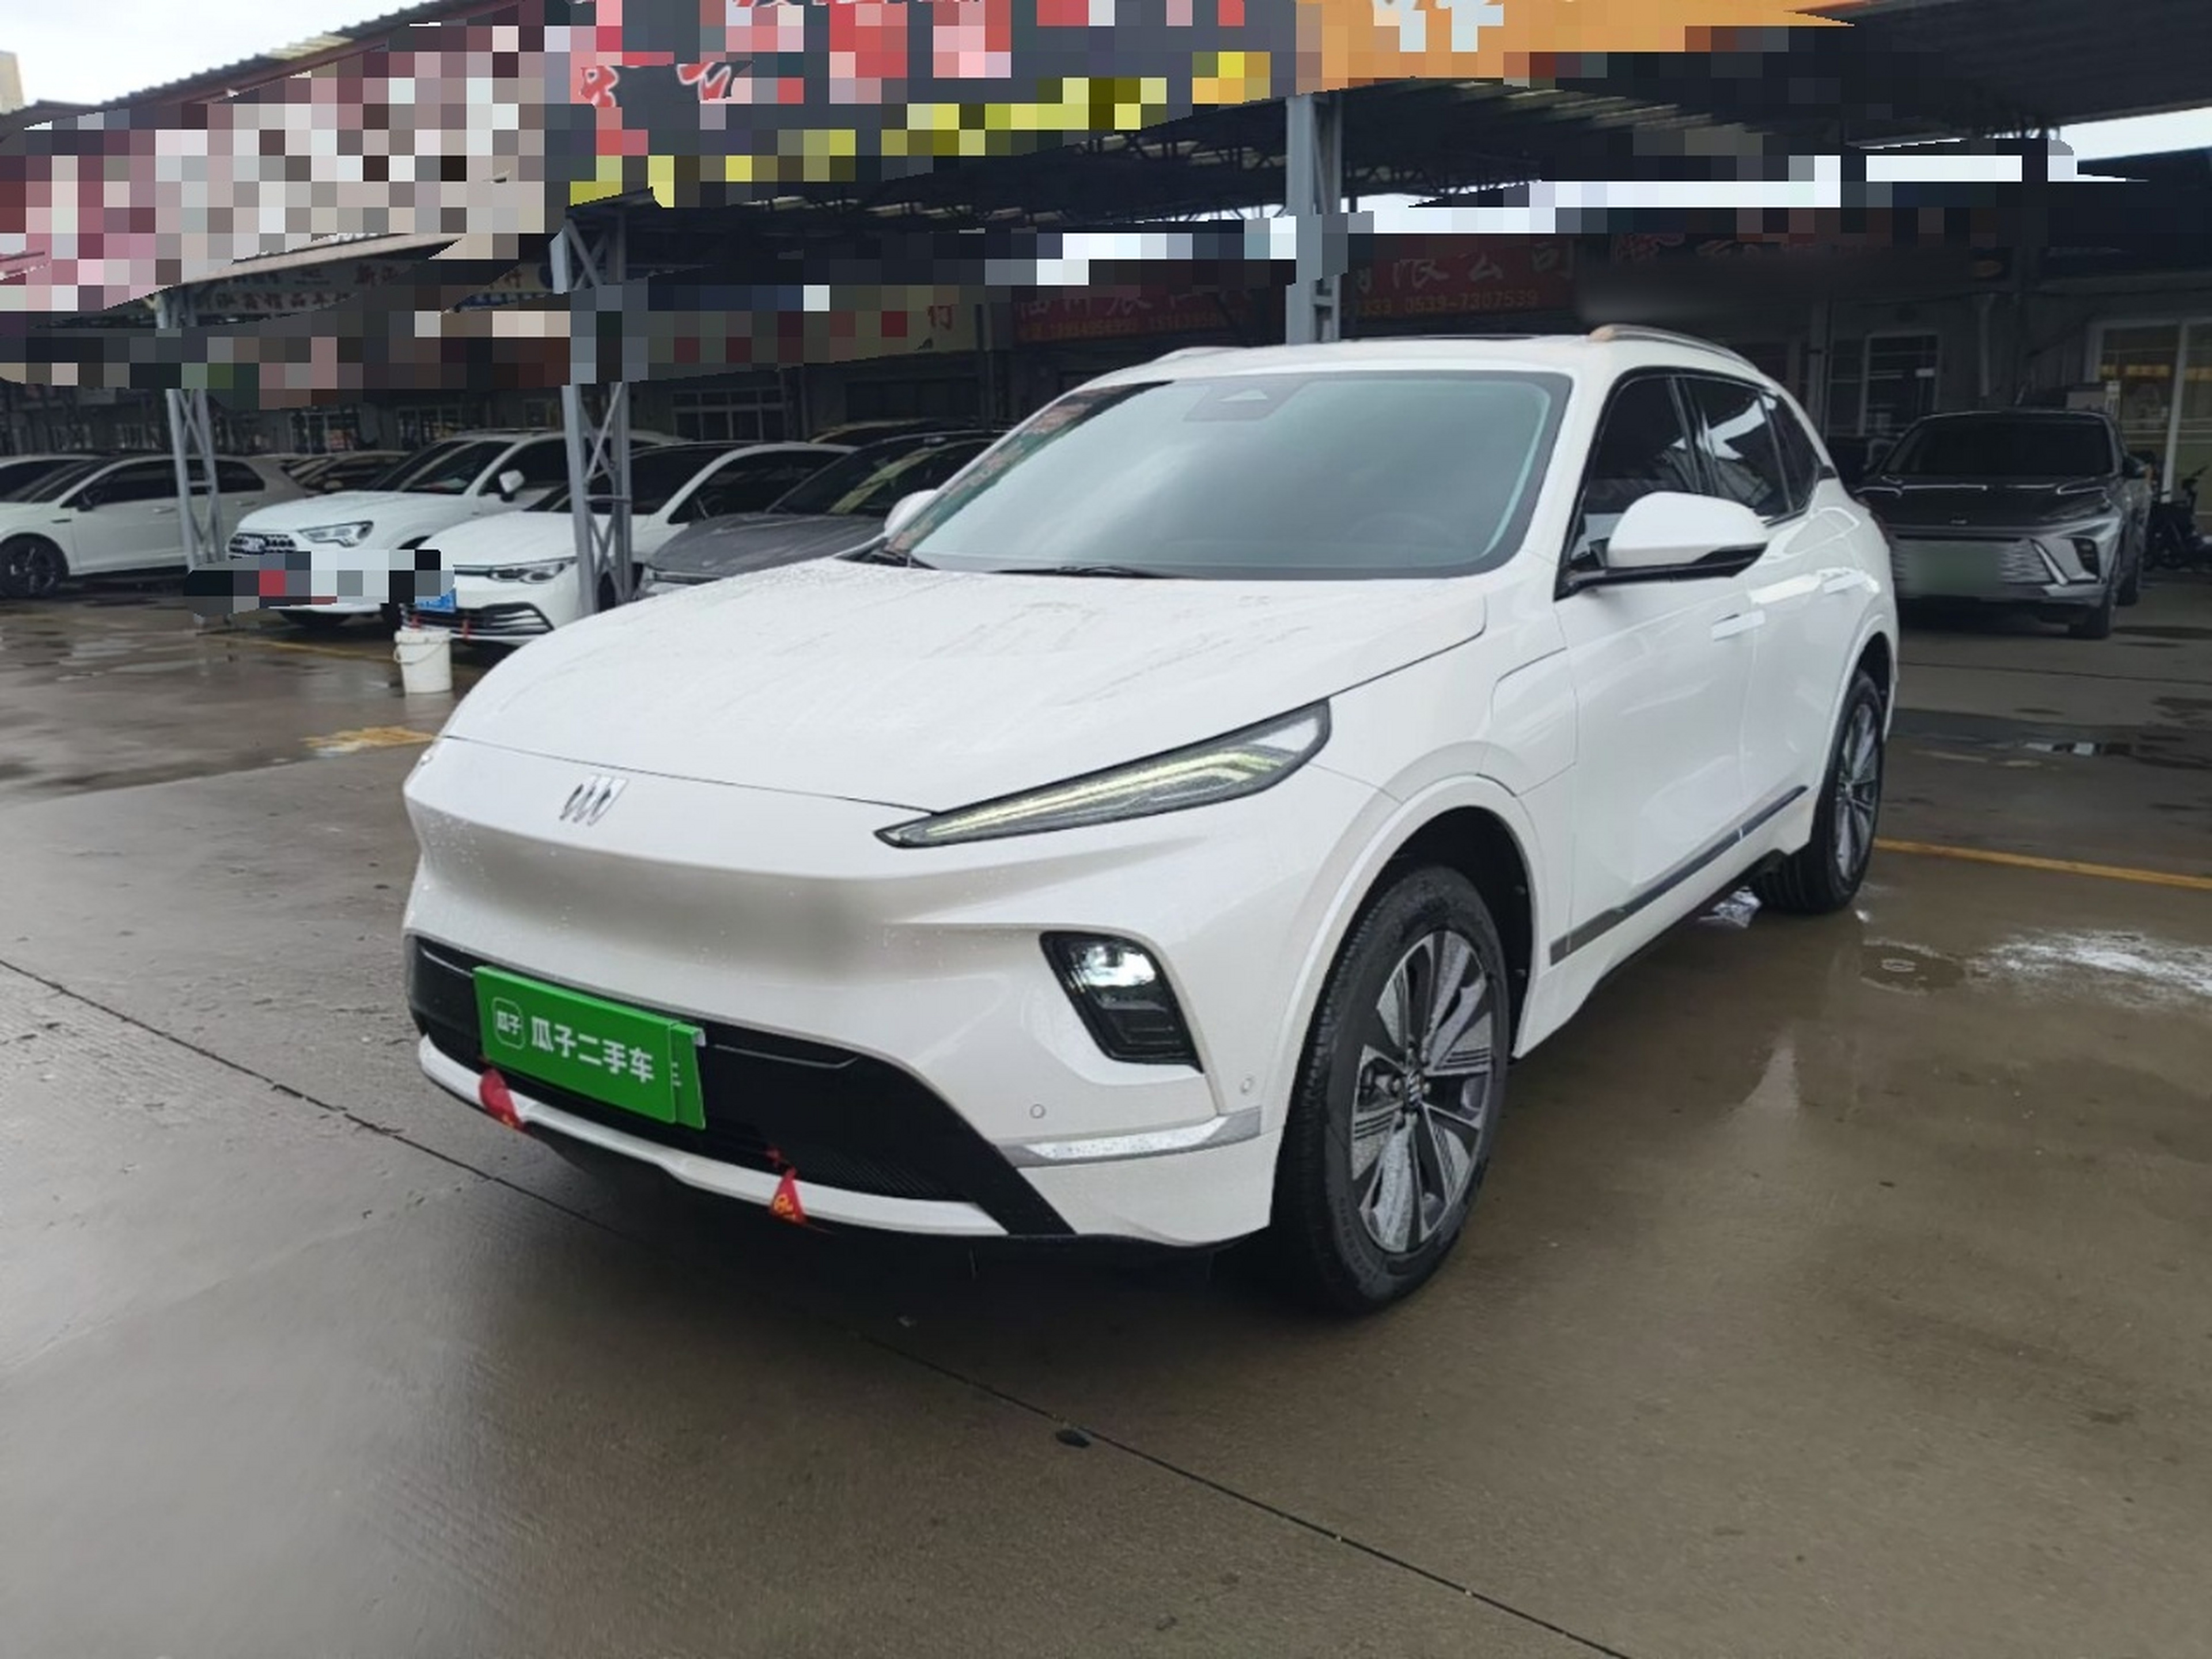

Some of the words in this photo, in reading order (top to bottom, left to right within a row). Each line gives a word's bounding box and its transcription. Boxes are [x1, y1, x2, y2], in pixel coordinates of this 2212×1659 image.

[530, 1016, 656, 1084] 瓜子二手车
